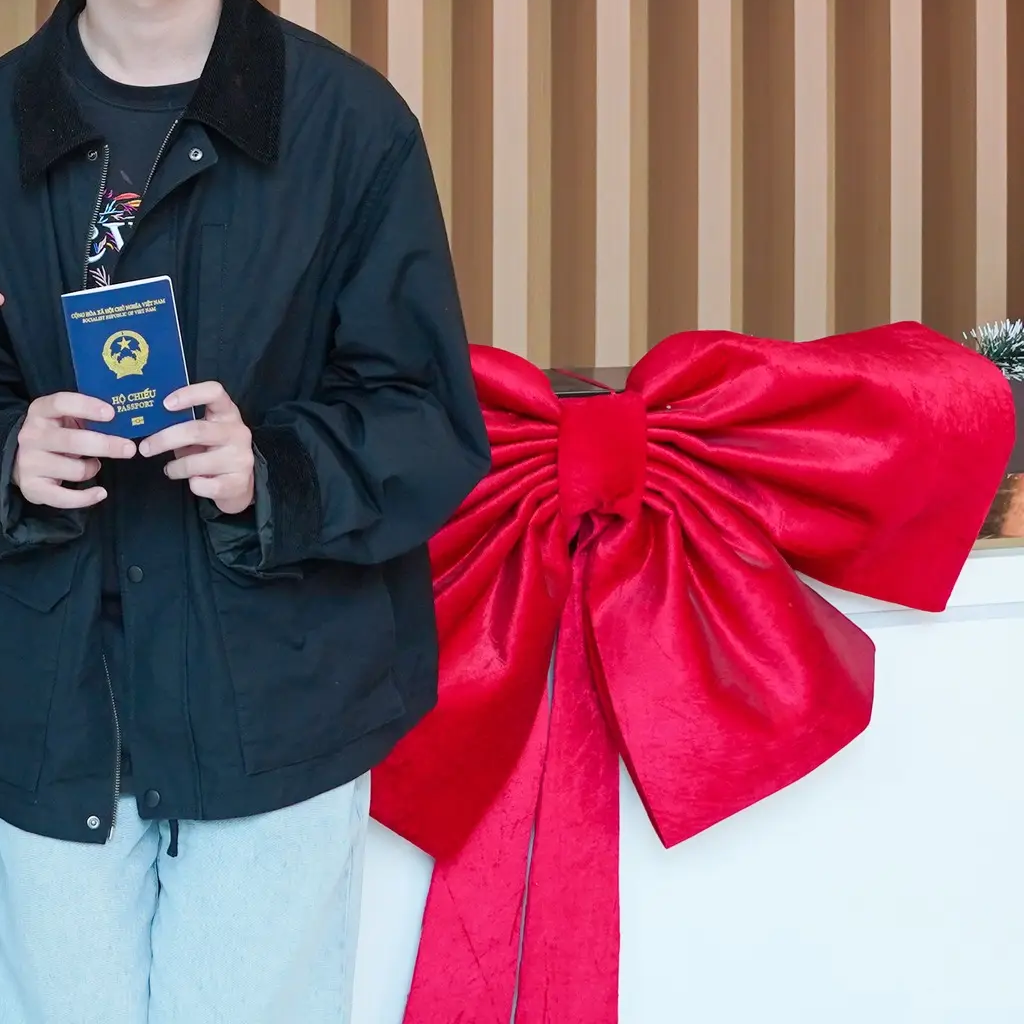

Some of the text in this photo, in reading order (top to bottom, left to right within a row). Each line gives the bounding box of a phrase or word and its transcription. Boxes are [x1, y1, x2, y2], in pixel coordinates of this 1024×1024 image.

[112, 388, 156, 405] HỘ CHIẾU
[117, 400, 154, 412] PASSPORT
